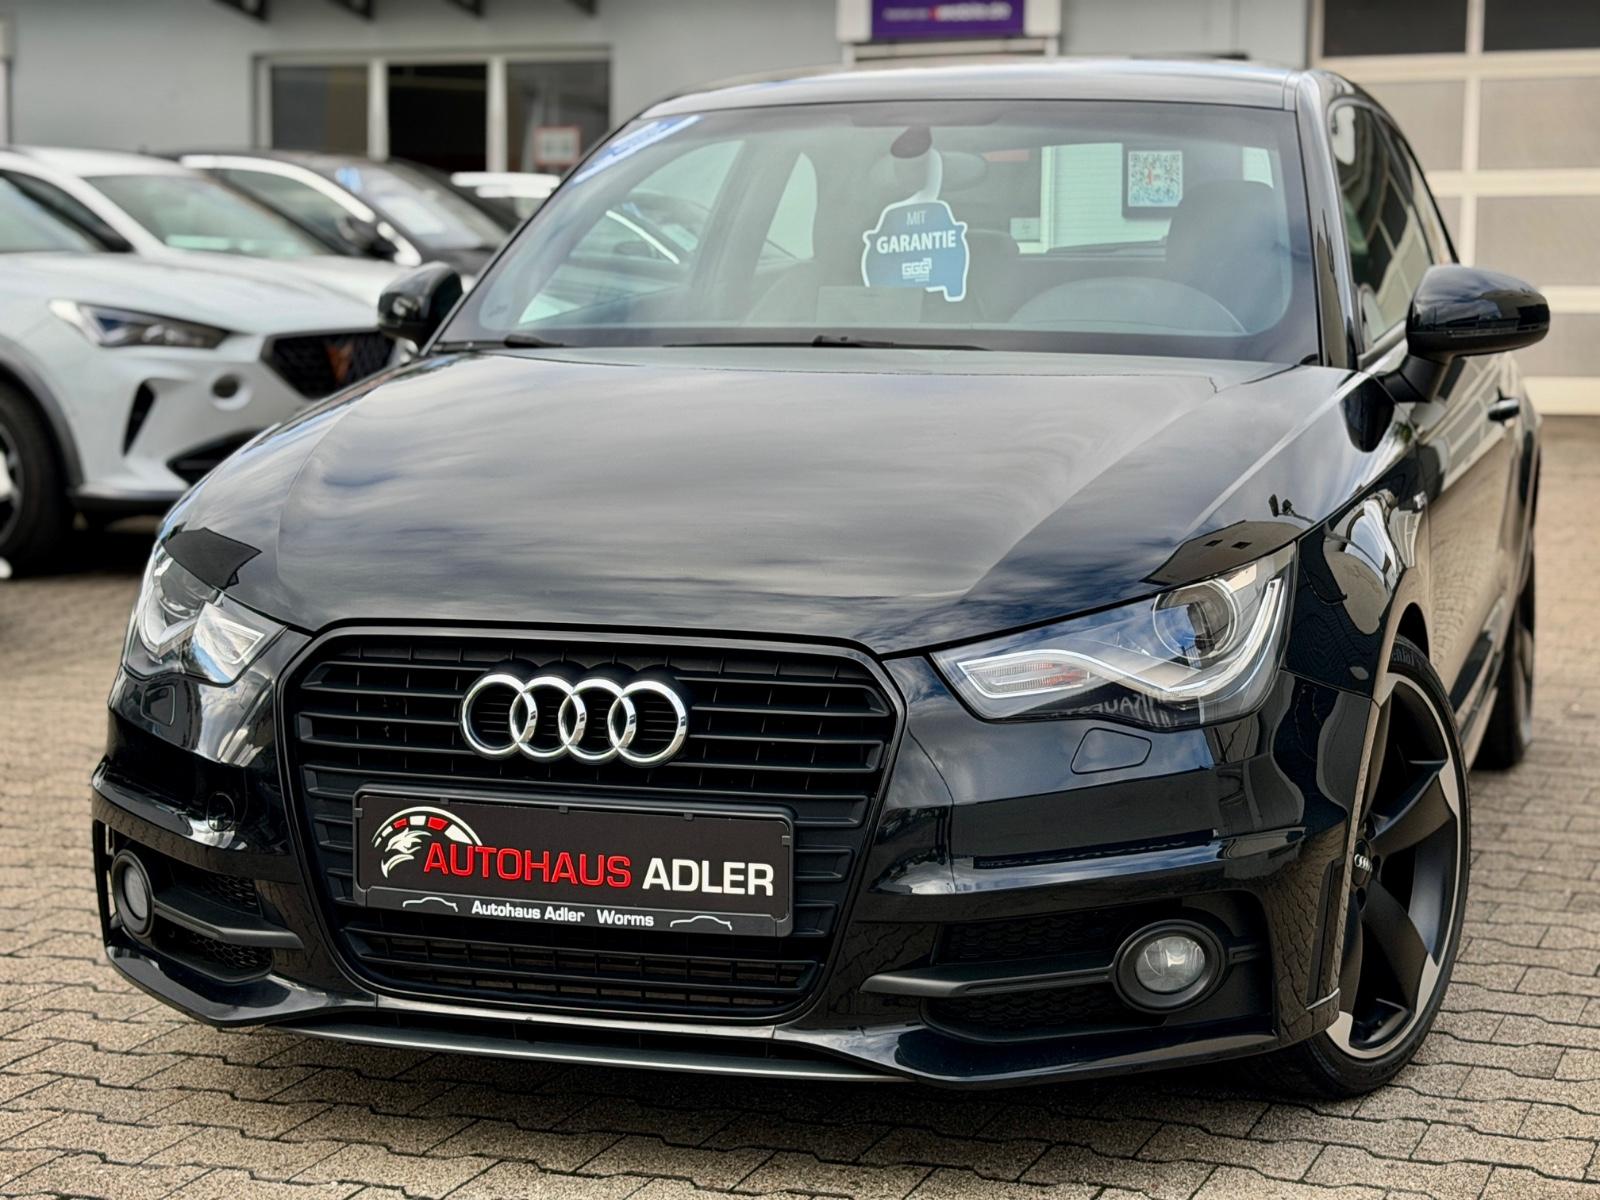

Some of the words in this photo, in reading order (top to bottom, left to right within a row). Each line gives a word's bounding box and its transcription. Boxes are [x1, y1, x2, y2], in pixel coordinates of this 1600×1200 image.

[906, 210, 926, 225] MIT
[876, 230, 957, 254] GARANTIE
[423, 843, 632, 888] AUTOHAUS
[642, 857, 774, 896] ADLER
[471, 900, 541, 920] Autohaus
[544, 906, 586, 923] Adler
[596, 909, 655, 927] Worms
